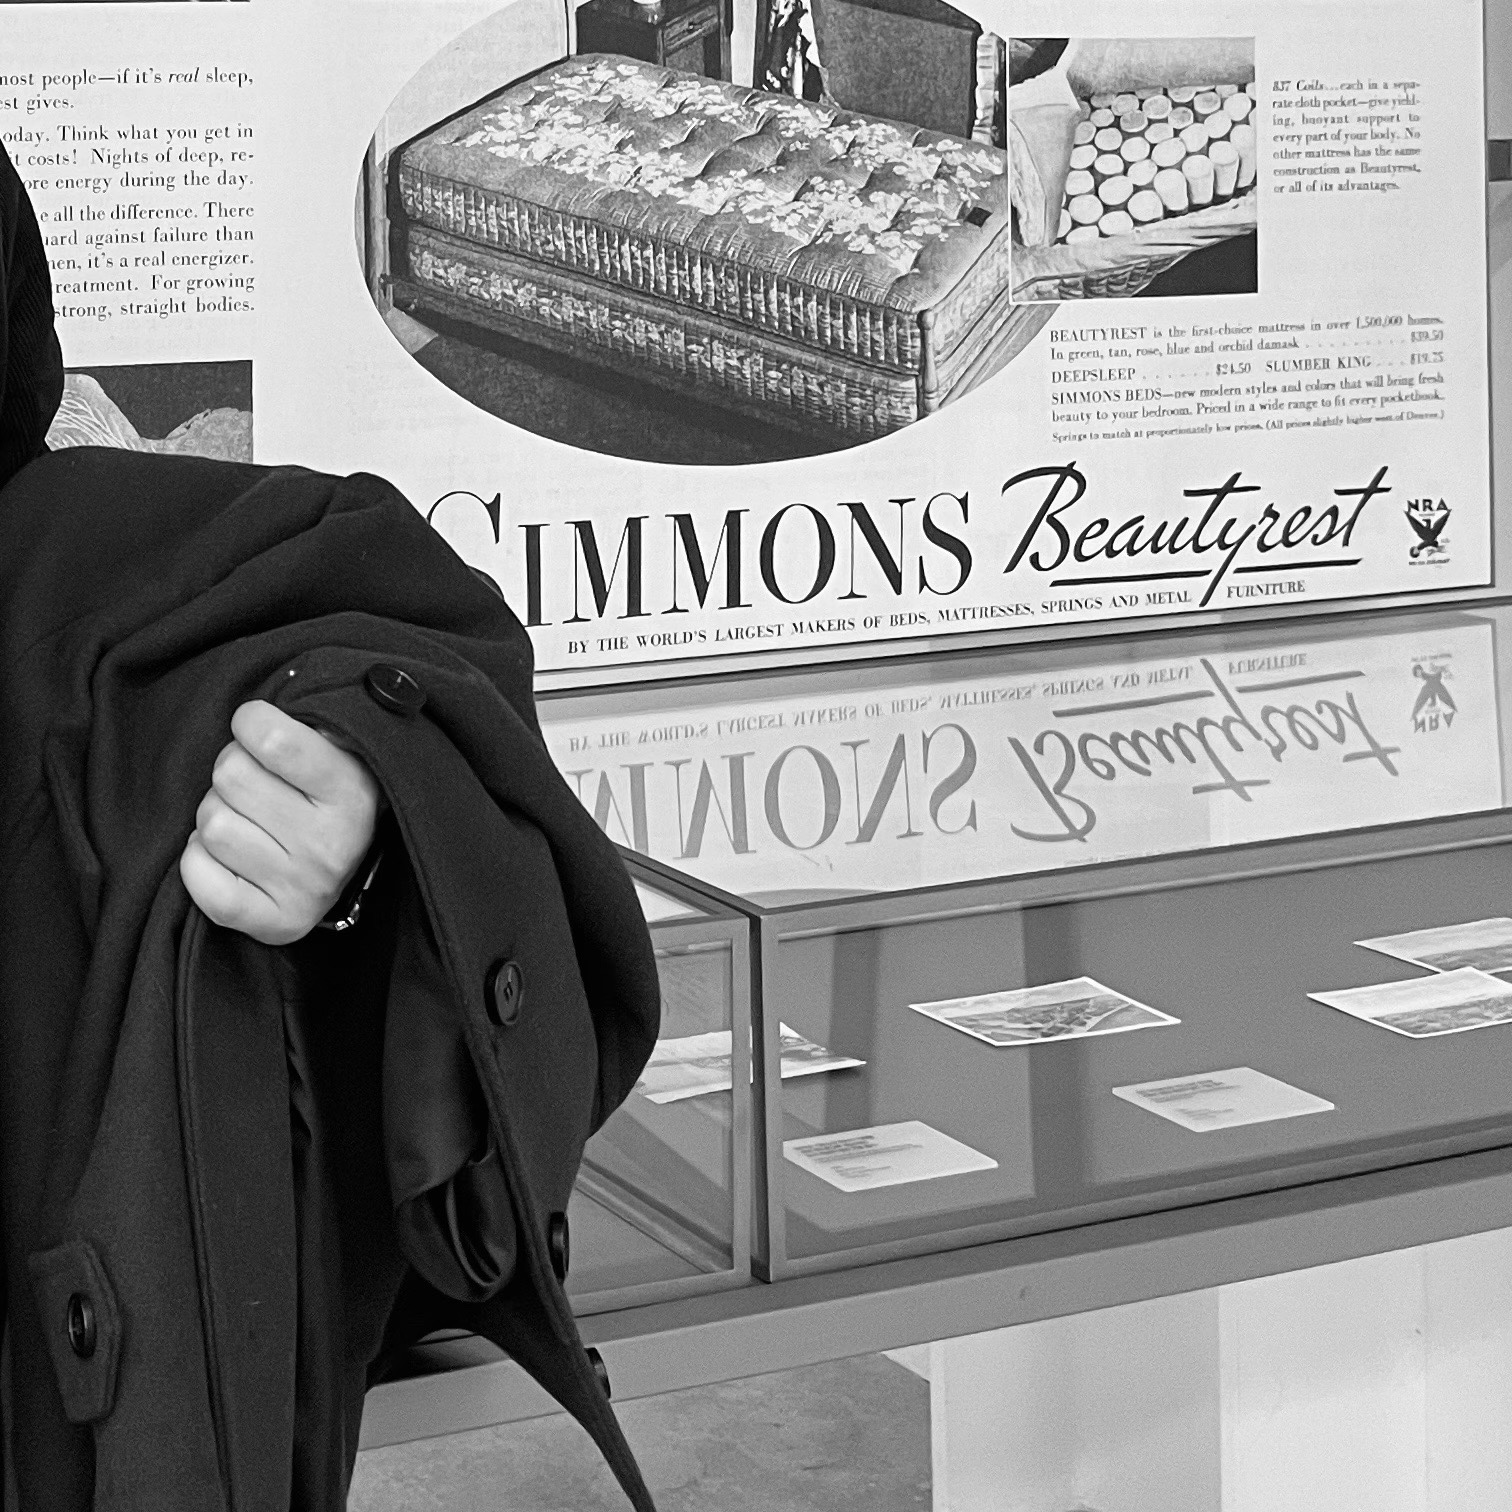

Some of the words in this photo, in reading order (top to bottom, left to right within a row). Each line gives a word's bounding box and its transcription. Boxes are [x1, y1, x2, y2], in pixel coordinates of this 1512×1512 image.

[43, 68, 129, 90] people—if
[136, 68, 161, 83] it's
[169, 67, 199, 82] real
[207, 68, 252, 87] sleep,
[57, 125, 108, 141] Think
[118, 125, 157, 139] what
[167, 127, 196, 144] you
[205, 127, 229, 142] get
[238, 125, 252, 137] in
[1371, 128, 1400, 142] body.
[1406, 128, 1420, 138] No
[121, 298, 186, 317] straight
[197, 296, 254, 312] bodies.
[1407, 497, 1449, 512] NRA
[1000, 460, 1394, 609] Beautyrest
[569, 641, 588, 653] BY
[599, 637, 628, 651] THE
[637, 632, 706, 647] WORLD'S
[716, 624, 783, 641] LARGEST
[793, 619, 855, 633] MAKERS
[863, 616, 881, 628] OF
[890, 613, 930, 626] BEDS,
[939, 604, 1034, 622] MATTRESSES,
[1042, 598, 1102, 612] SPRINGS
[1111, 595, 1138, 607] AND
[1147, 591, 1190, 605] METAL
[1227, 581, 1305, 598] FURNITURE
